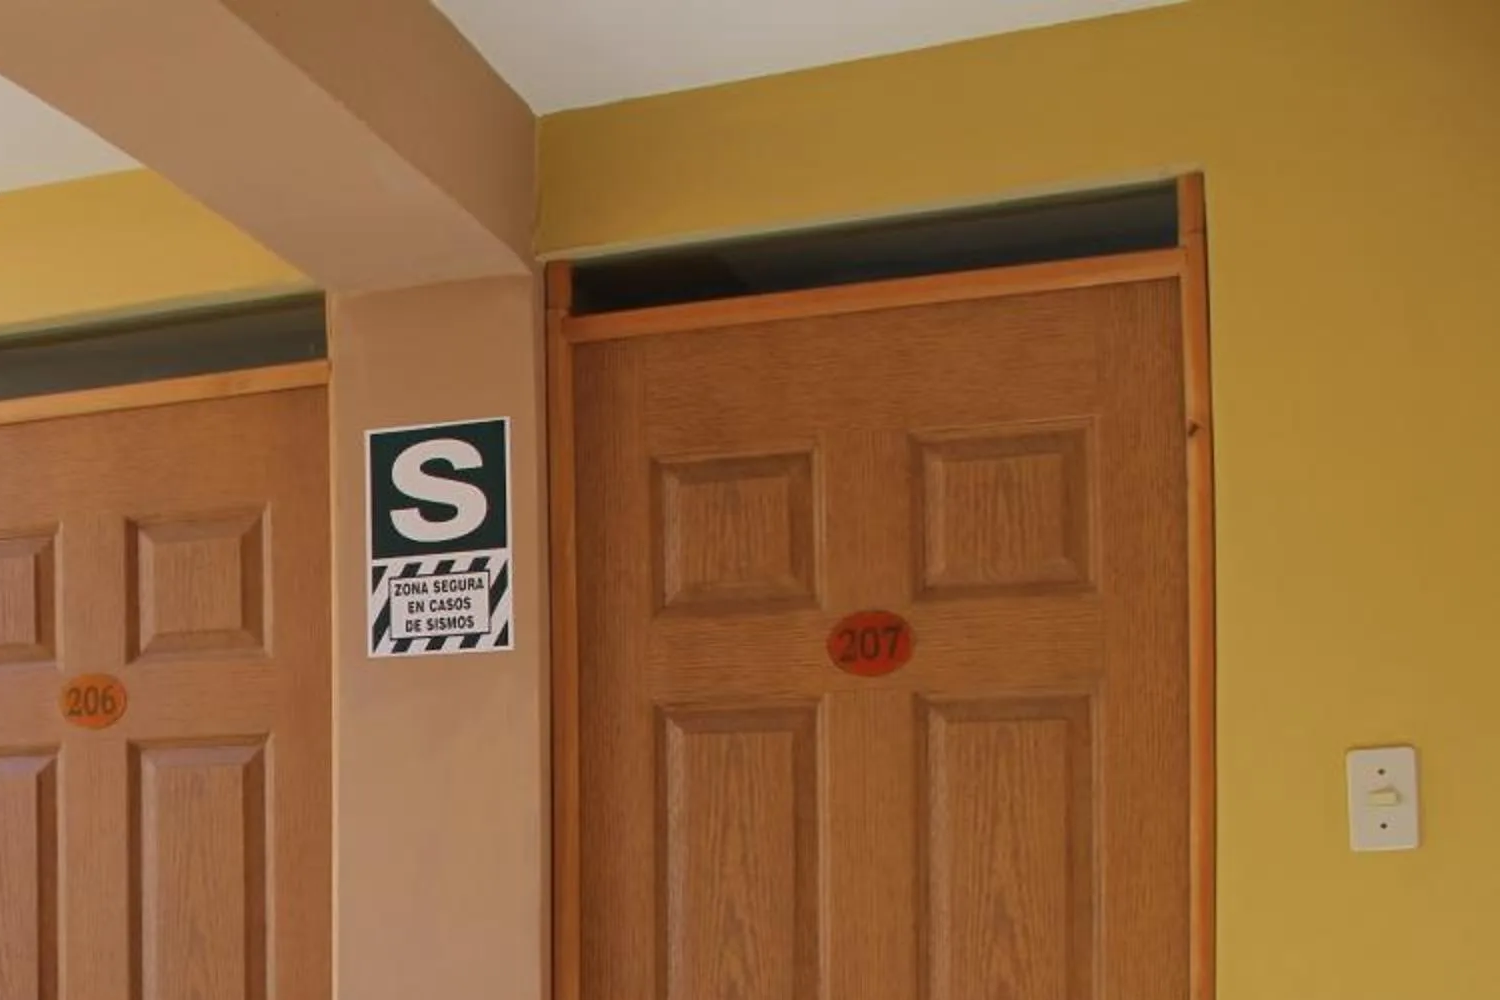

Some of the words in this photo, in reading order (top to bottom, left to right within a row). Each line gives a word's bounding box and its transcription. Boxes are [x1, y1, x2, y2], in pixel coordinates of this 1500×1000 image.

[390, 438, 488, 543] S
[394, 582, 429, 597] ZONA
[433, 577, 485, 593] SEGURA
[407, 601, 425, 614] EN
[429, 596, 472, 613] CASOS
[405, 619, 422, 633] DE
[426, 615, 475, 631] SISMOS
[839, 625, 903, 663] 207
[65, 685, 117, 716] 206
